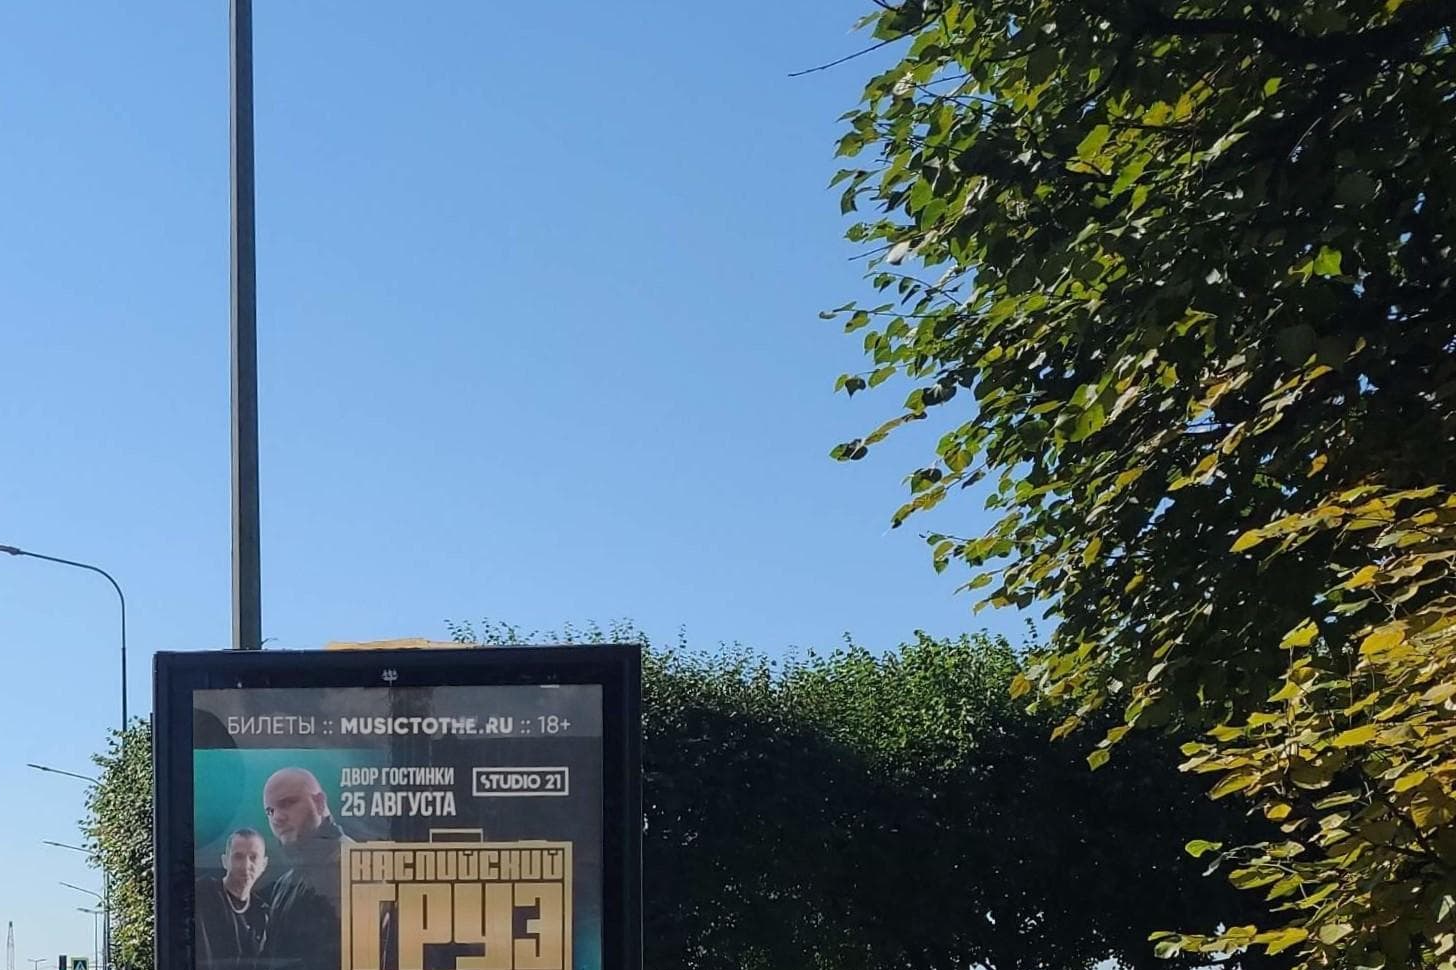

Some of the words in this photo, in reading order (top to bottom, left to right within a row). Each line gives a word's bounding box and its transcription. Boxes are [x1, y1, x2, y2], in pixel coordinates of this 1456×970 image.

[227, 716, 315, 735] БИЛЕТЫ
[341, 716, 513, 735] MUSICTOTHE.RU
[537, 715, 571, 734] 18+
[340, 767, 378, 787] ДВОР
[382, 767, 454, 785] ГОСТИНКИ
[480, 773, 541, 789] STUDIO
[545, 774, 561, 789] 21
[341, 791, 365, 816] 25
[370, 791, 456, 816] АВГУСТА
[350, 850, 563, 880] КАСПИЙСКИЙ
[351, 882, 563, 970] ГРУЗ
